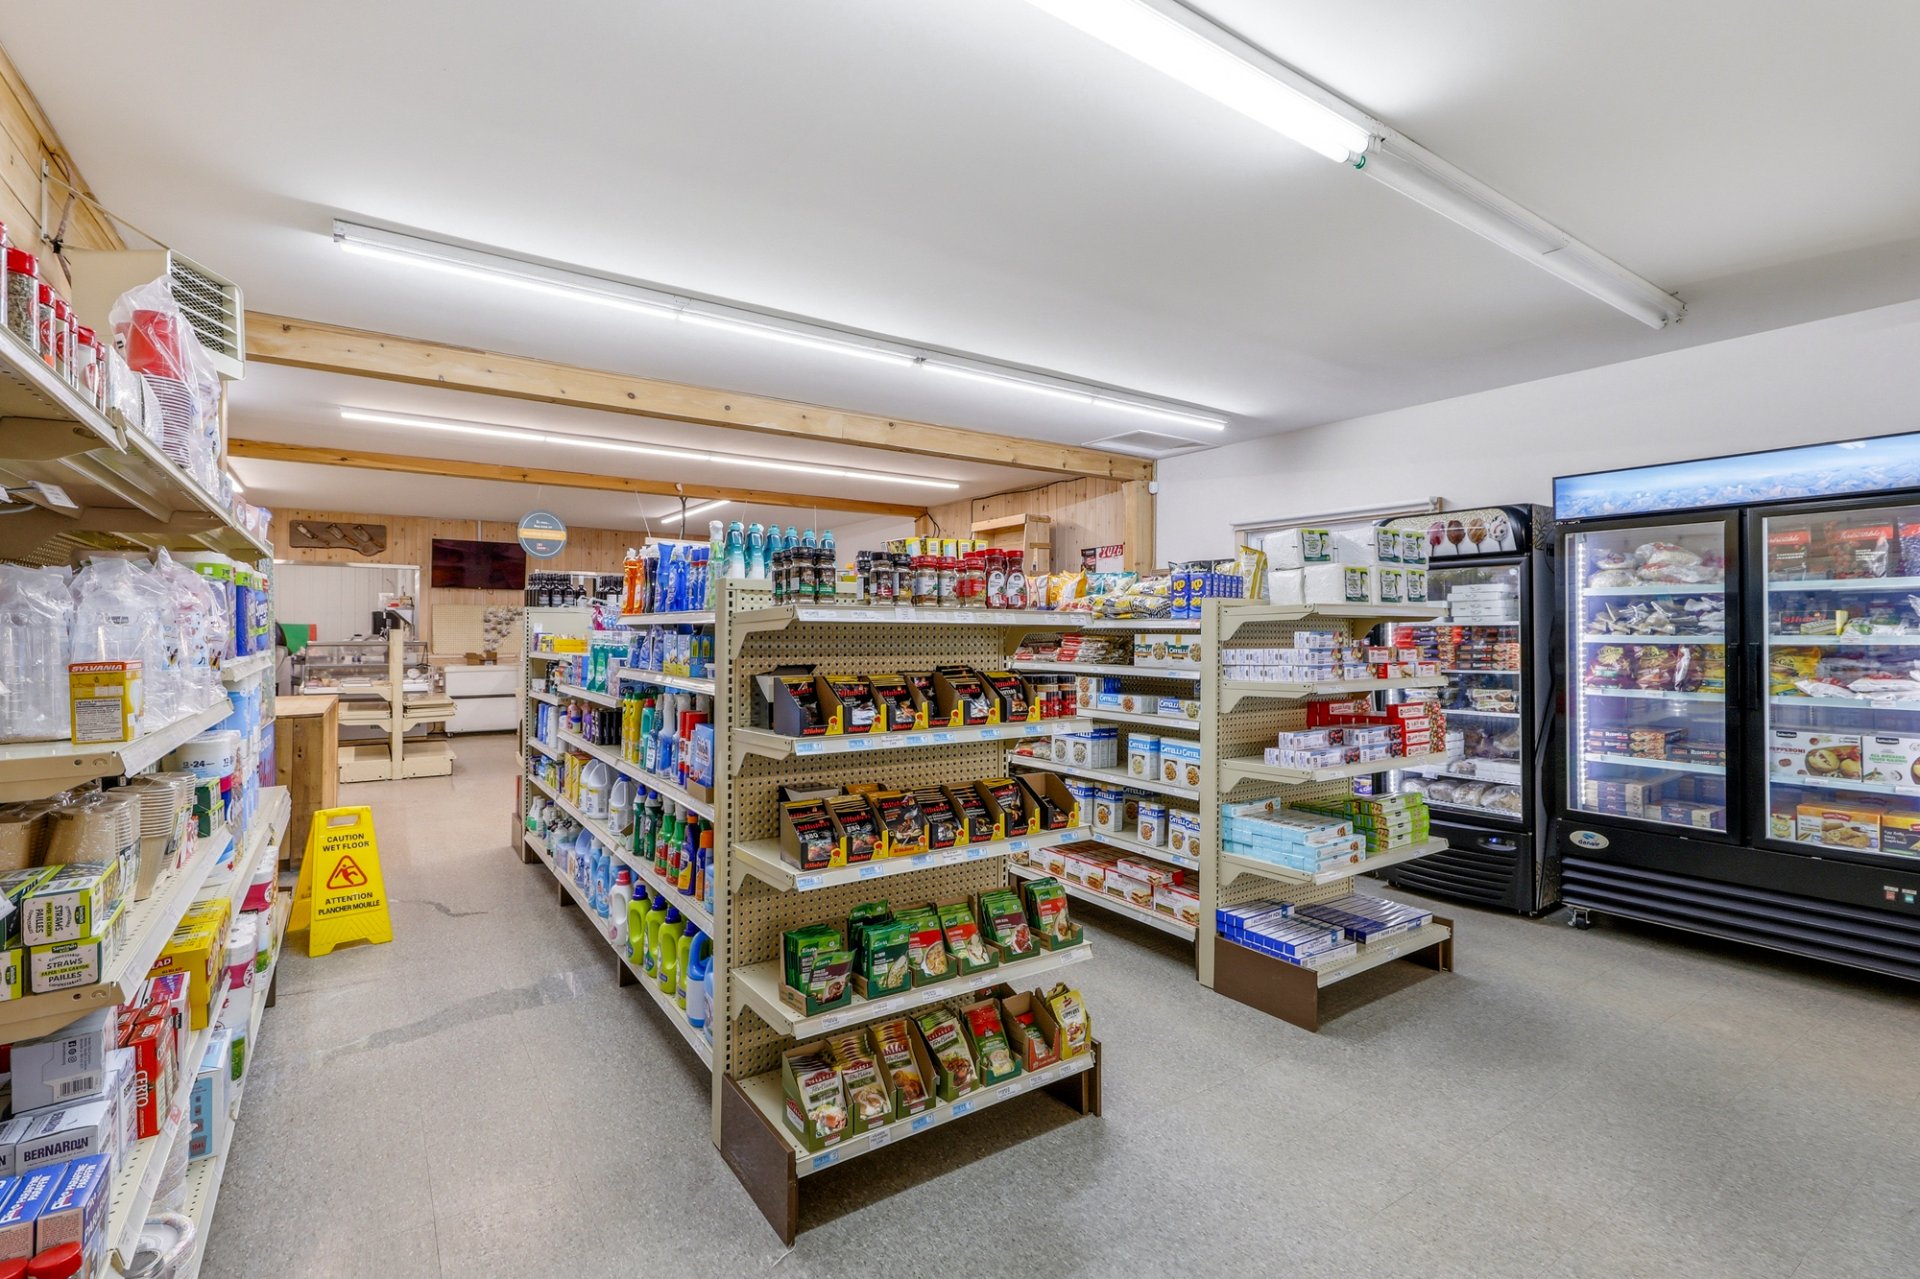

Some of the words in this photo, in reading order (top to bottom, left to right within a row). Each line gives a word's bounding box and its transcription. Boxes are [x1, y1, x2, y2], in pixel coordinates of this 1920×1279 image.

[1174, 580, 1186, 591] KD
[1191, 578, 1203, 590] KD
[71, 664, 123, 672] SYLVANIA
[327, 833, 365, 843] CAUTION
[322, 844, 340, 852] WET
[342, 841, 370, 850] FLOOR
[325, 892, 373, 905] ATTENTION
[318, 904, 352, 916] PLANCHER
[36, 908, 44, 933] PAILLES
[54, 905, 63, 932] STRAWS
[47, 957, 83, 970] STRAWS
[48, 971, 82, 982] PAILLES
[136, 1070, 149, 1108] CERTO
[24, 1137, 89, 1162] BERNARDIN
